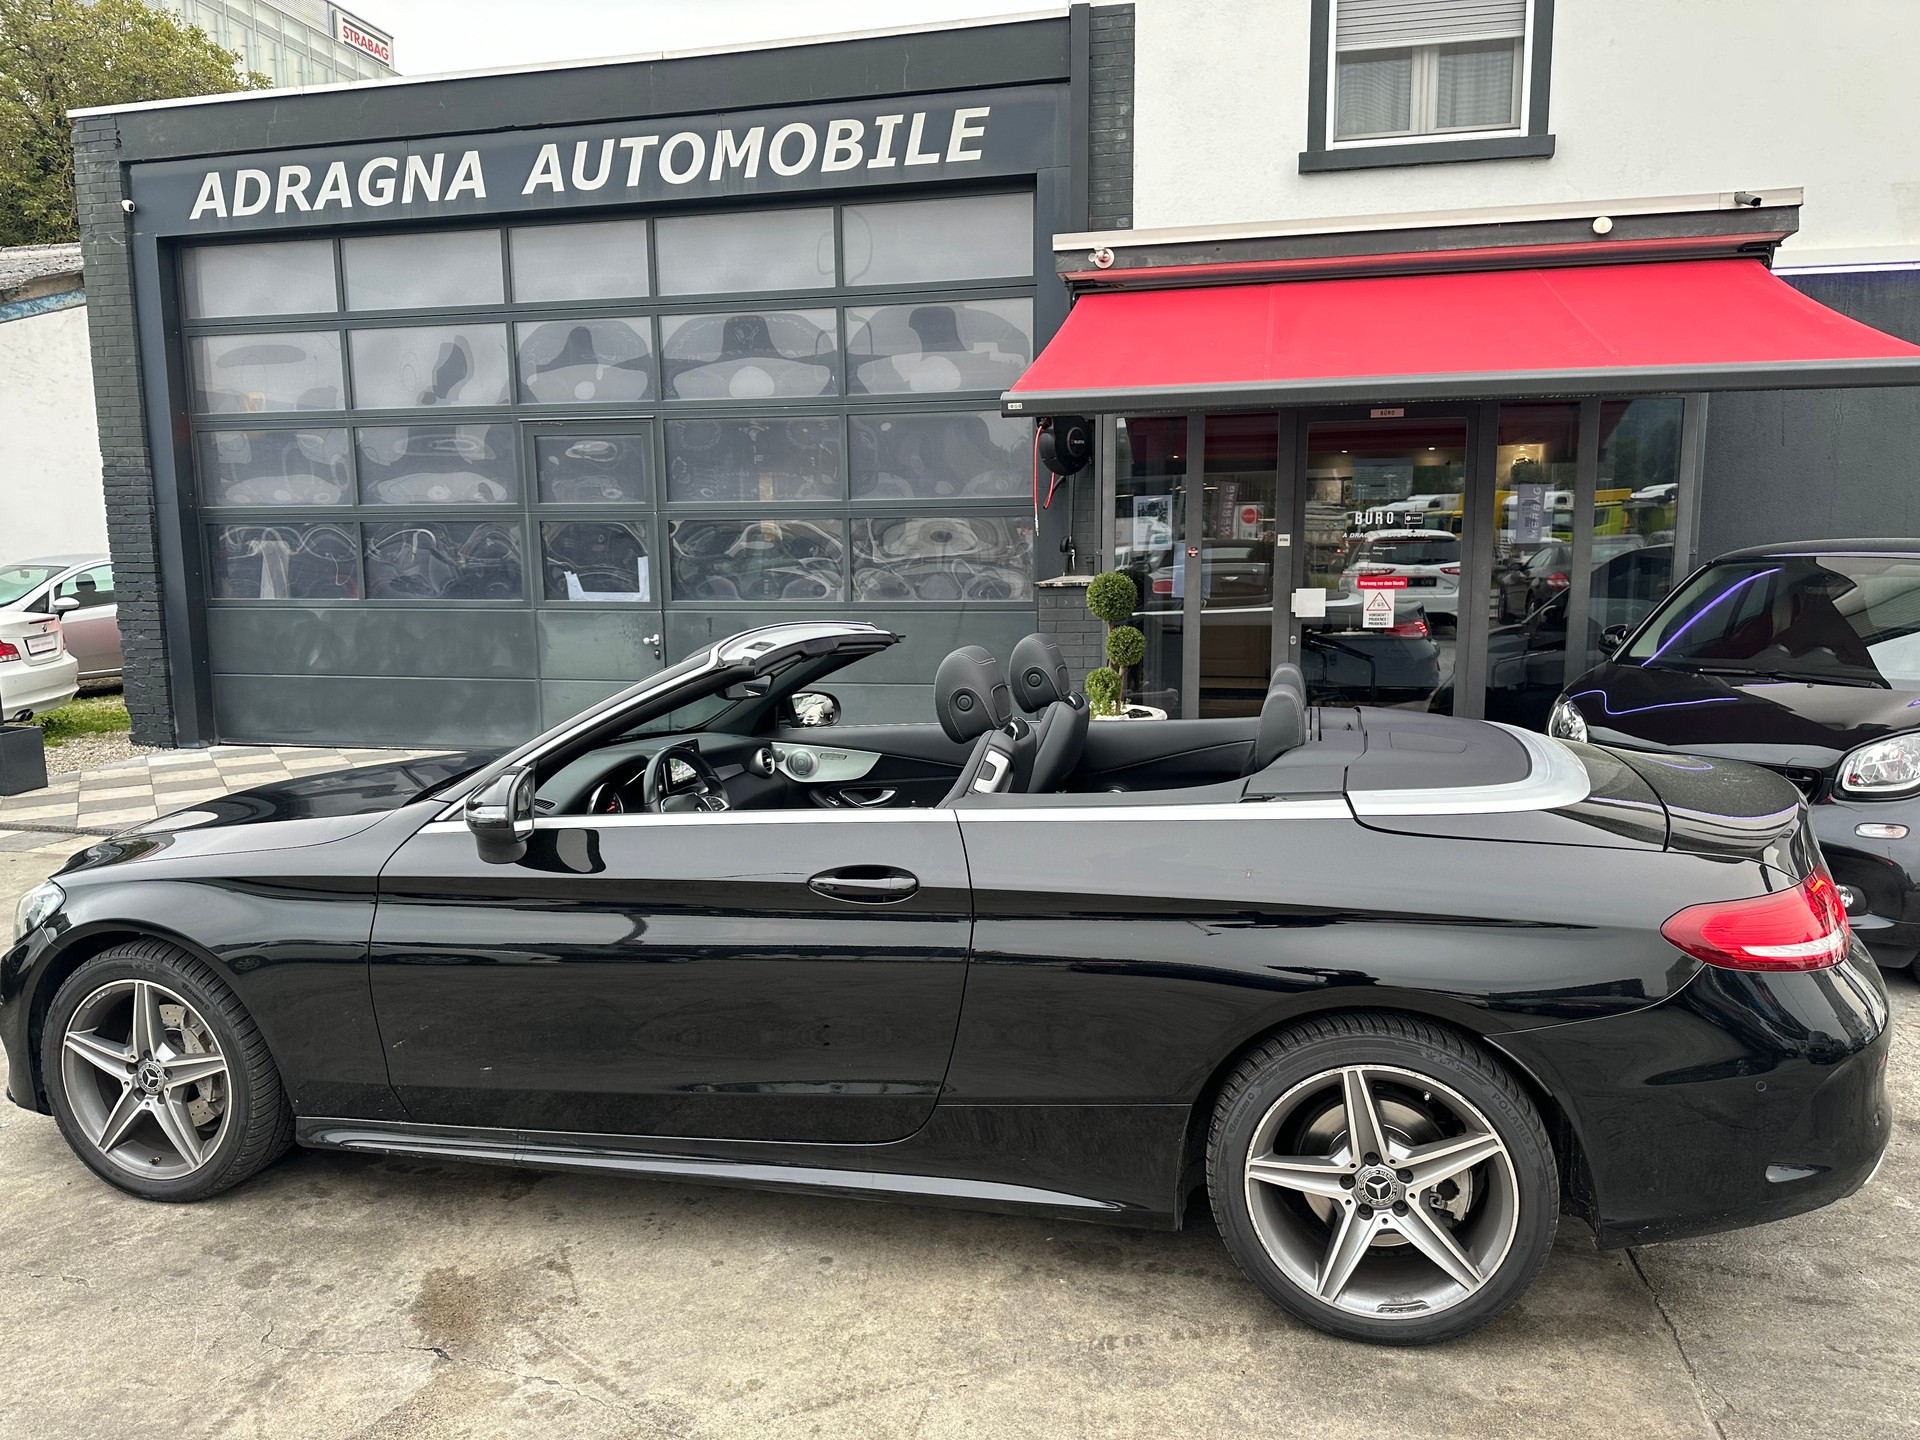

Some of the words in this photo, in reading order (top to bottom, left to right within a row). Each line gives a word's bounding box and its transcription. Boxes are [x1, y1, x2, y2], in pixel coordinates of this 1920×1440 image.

[343, 25, 389, 60] STRABAG
[189, 150, 487, 220] ADRAGNA
[521, 106, 991, 195] AUTOMOBILE
[1220, 485, 1236, 537] MERBAG
[1354, 509, 1394, 525] BÜRO
[1527, 487, 1542, 539] MERBAG
[1492, 1093, 1531, 1145] POLARIS
